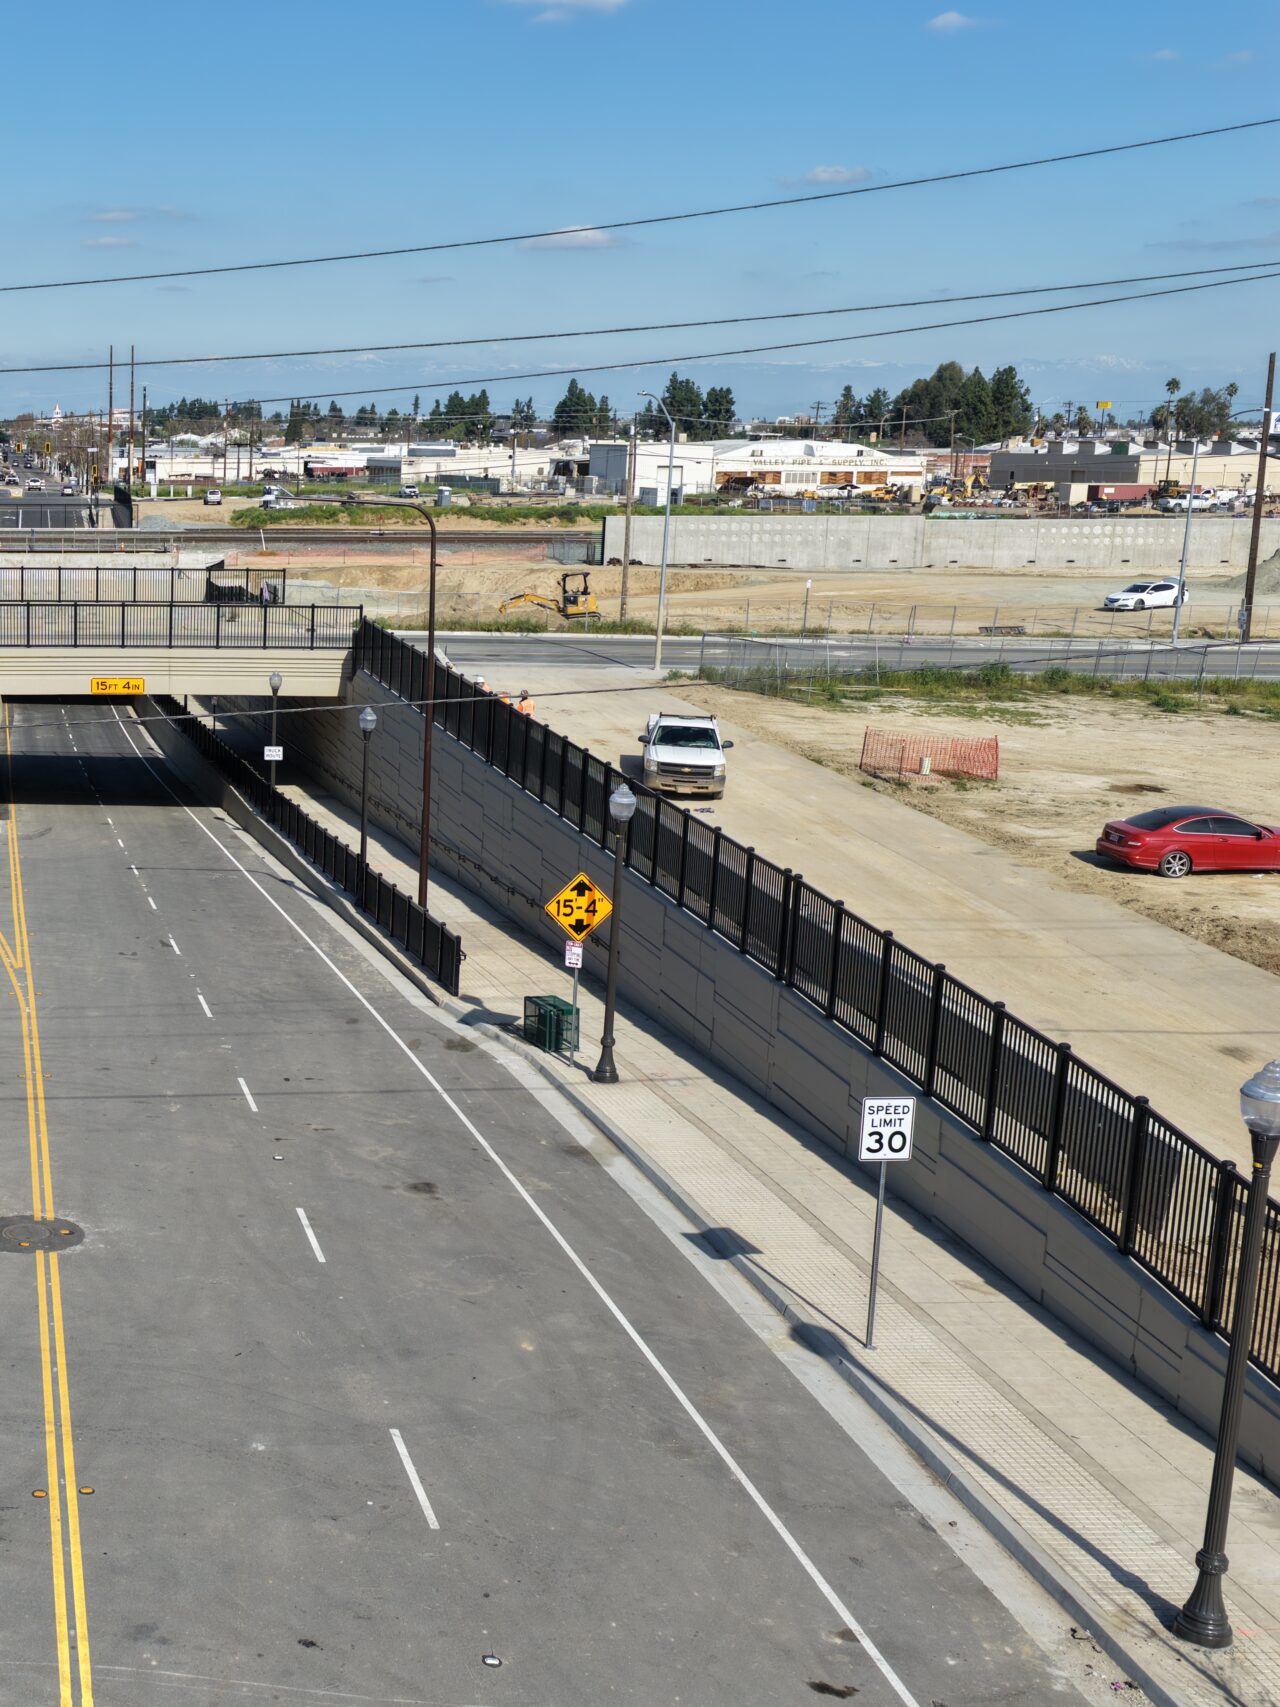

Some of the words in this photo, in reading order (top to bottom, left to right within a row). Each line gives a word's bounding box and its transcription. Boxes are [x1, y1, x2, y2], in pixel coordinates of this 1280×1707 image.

[753, 458, 785, 466] VALLEY
[792, 458, 811, 466] PIPE
[868, 1105, 910, 1115] SPEED
[871, 1118, 904, 1128] LIMIT
[866, 1130, 906, 1154] 30
